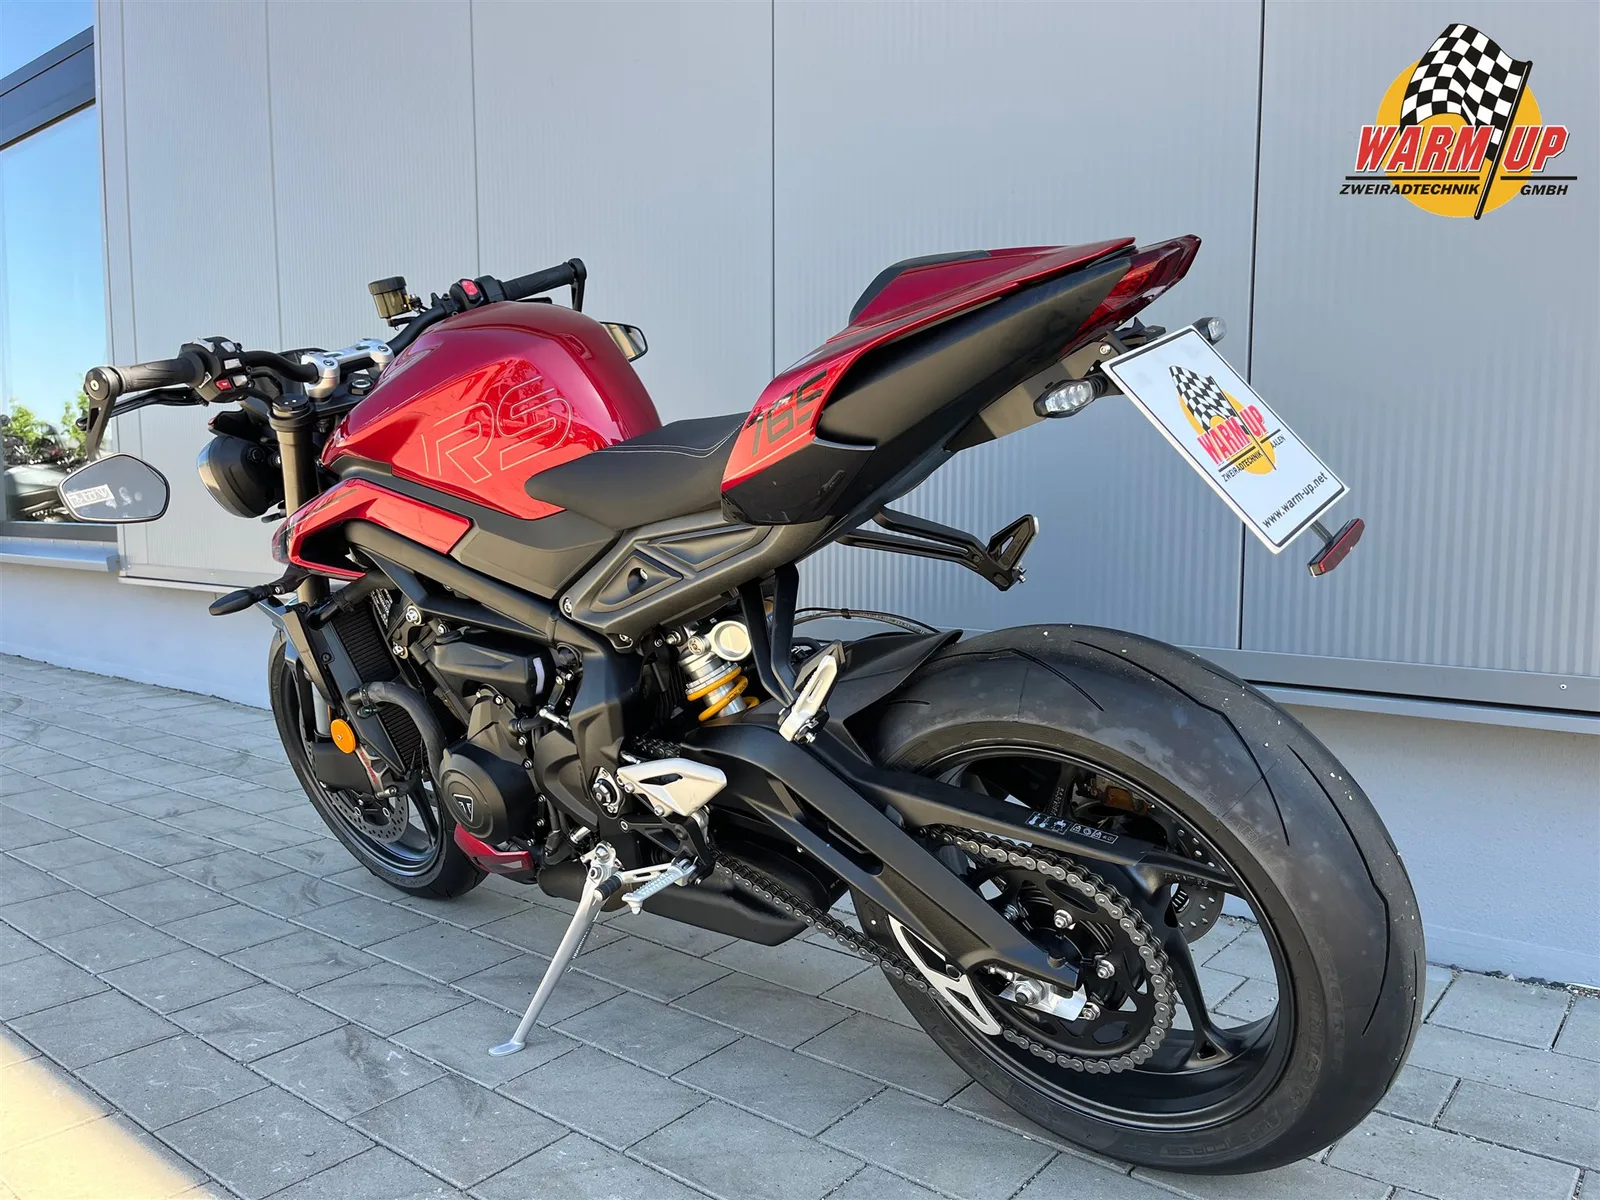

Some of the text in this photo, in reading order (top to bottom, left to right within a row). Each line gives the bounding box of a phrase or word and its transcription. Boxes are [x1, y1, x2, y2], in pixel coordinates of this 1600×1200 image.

[420, 376, 572, 484] RS
[1197, 404, 1268, 466] WARM UP
[1221, 434, 1286, 482] ZWEIRADTECHNIK AALEN
[1262, 471, 1328, 529] www.warm-up.net
